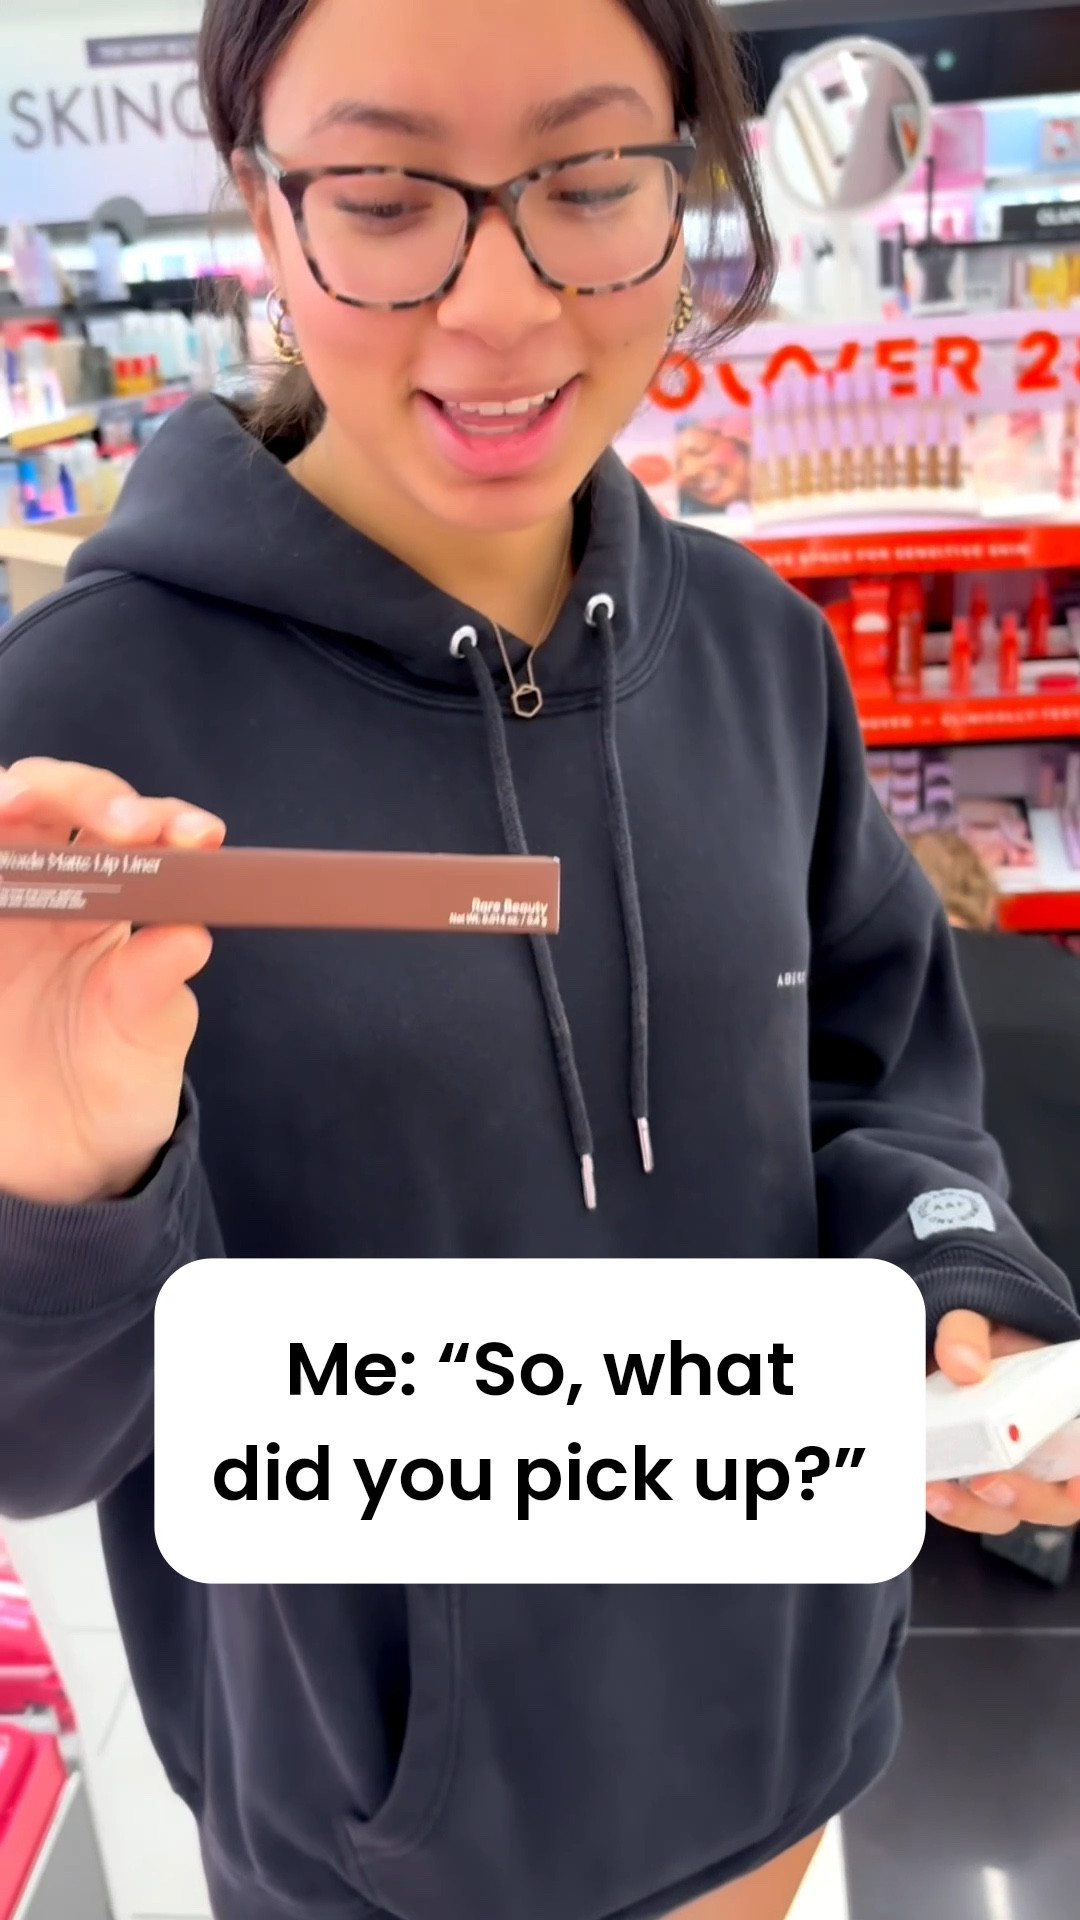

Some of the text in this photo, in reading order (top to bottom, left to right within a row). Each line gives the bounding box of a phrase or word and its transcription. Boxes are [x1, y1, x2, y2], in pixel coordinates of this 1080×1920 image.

[647, 331, 1080, 411] OWER 2
[93, 853, 121, 876] Lip
[122, 854, 163, 874] Liner
